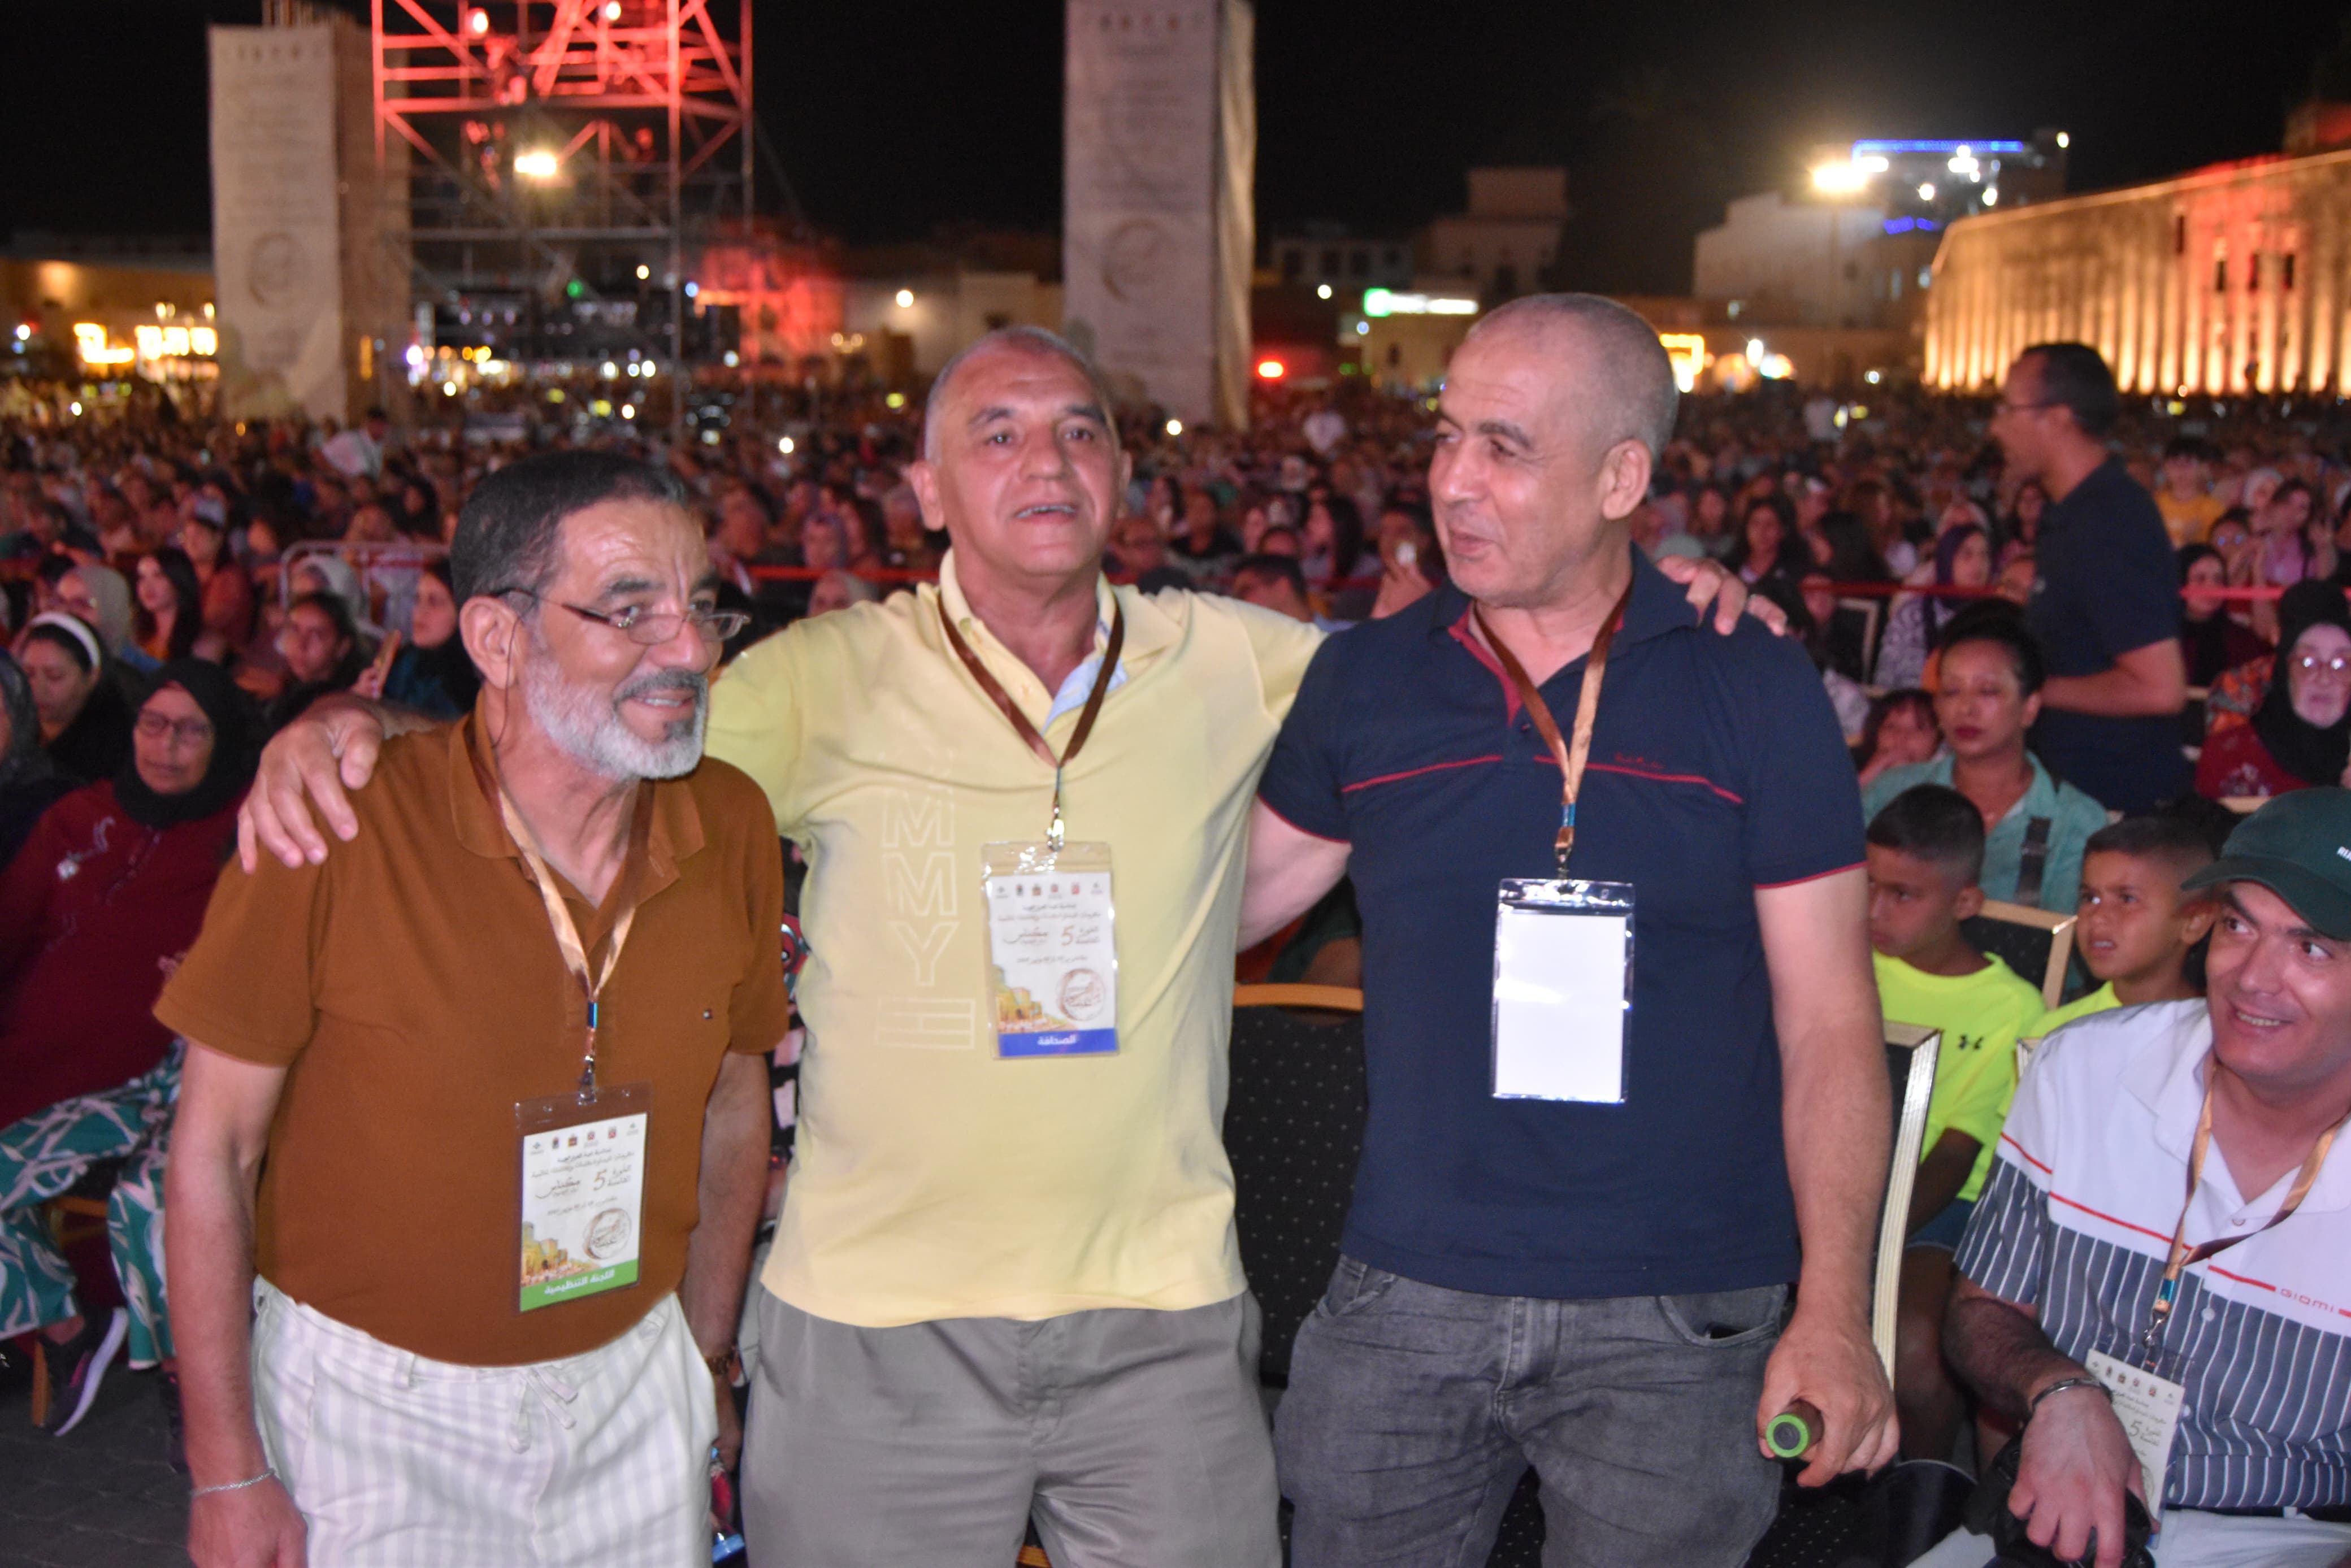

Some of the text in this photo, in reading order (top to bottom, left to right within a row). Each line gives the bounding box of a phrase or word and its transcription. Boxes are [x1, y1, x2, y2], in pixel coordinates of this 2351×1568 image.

[1060, 925, 1075, 947] 5
[593, 1169, 607, 1191] 5
[2128, 1419, 2142, 1437] 5
